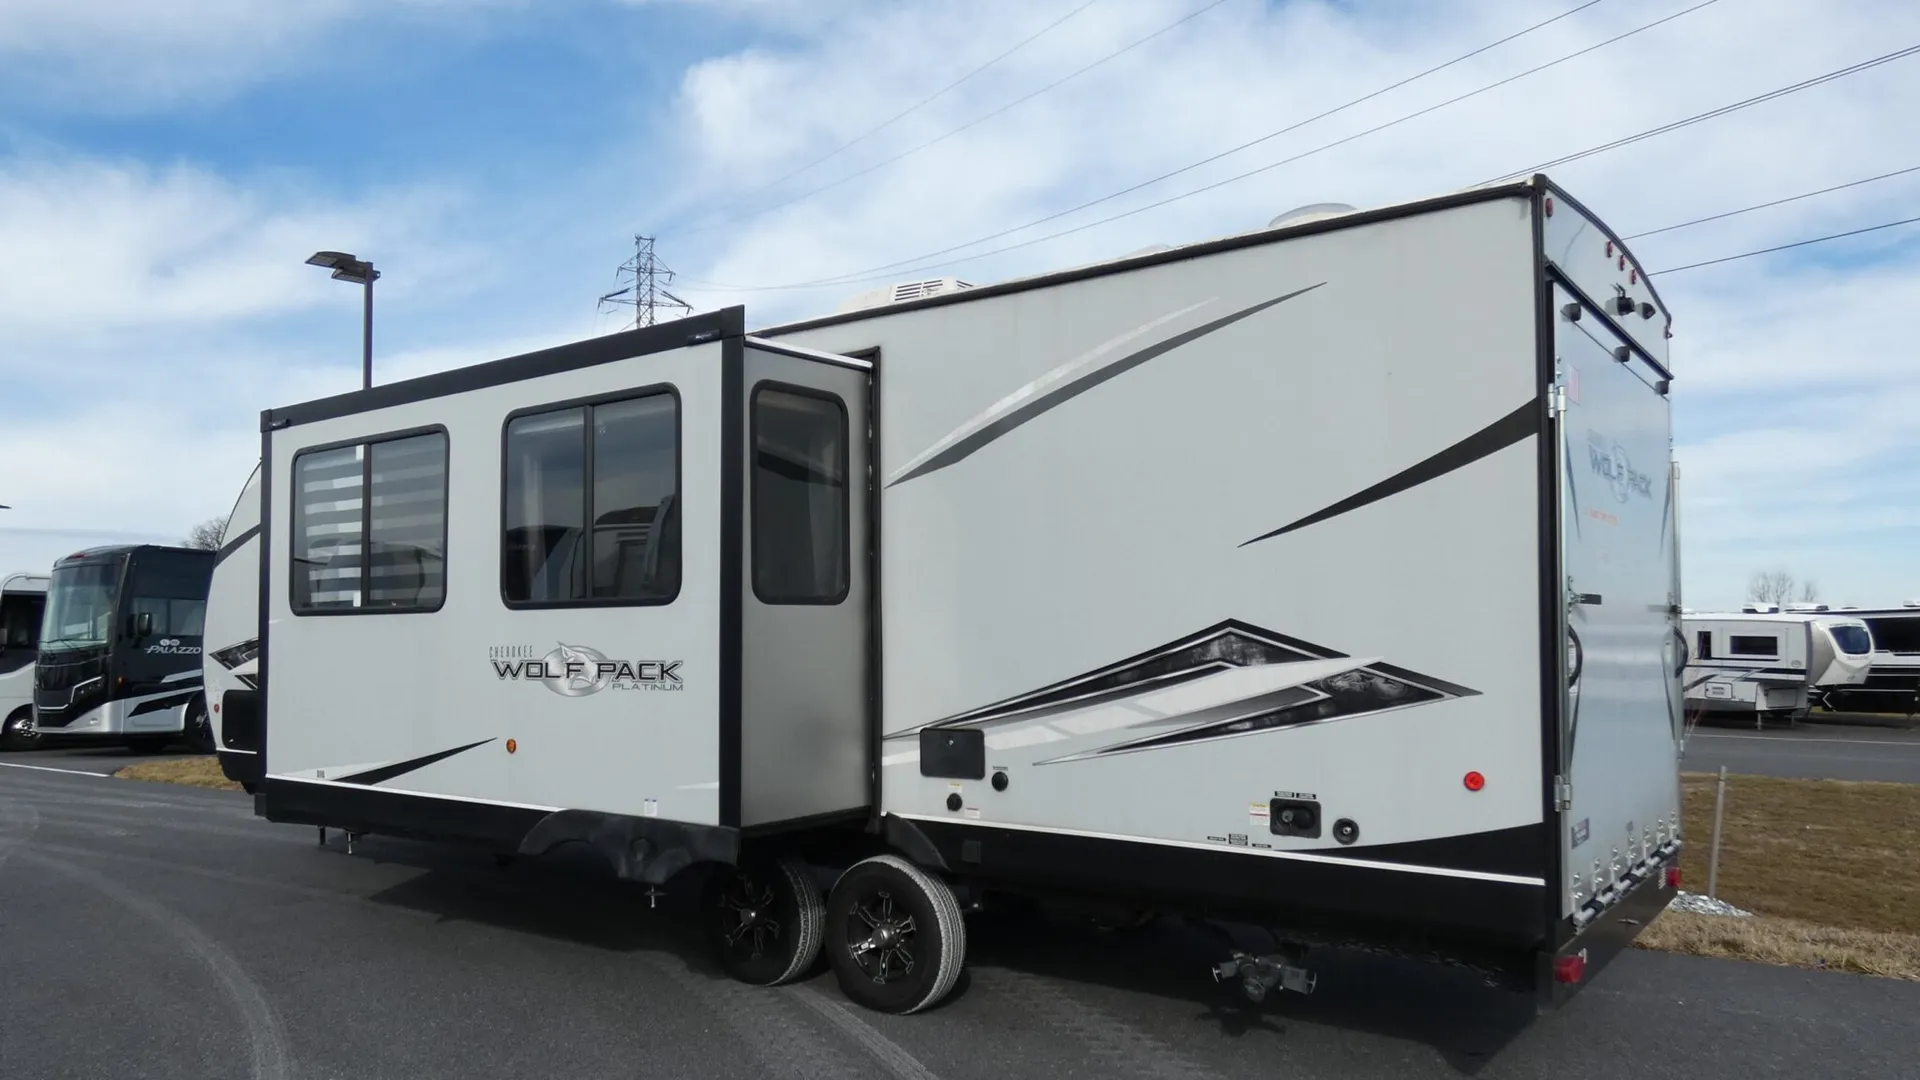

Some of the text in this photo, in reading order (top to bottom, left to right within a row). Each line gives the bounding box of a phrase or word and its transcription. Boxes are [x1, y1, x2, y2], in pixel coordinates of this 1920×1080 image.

[144, 645, 202, 654] PALAZZO
[489, 645, 533, 658] CHEROKEE
[490, 660, 684, 682] WOLF PACK
[612, 683, 684, 691] PLATINUM
